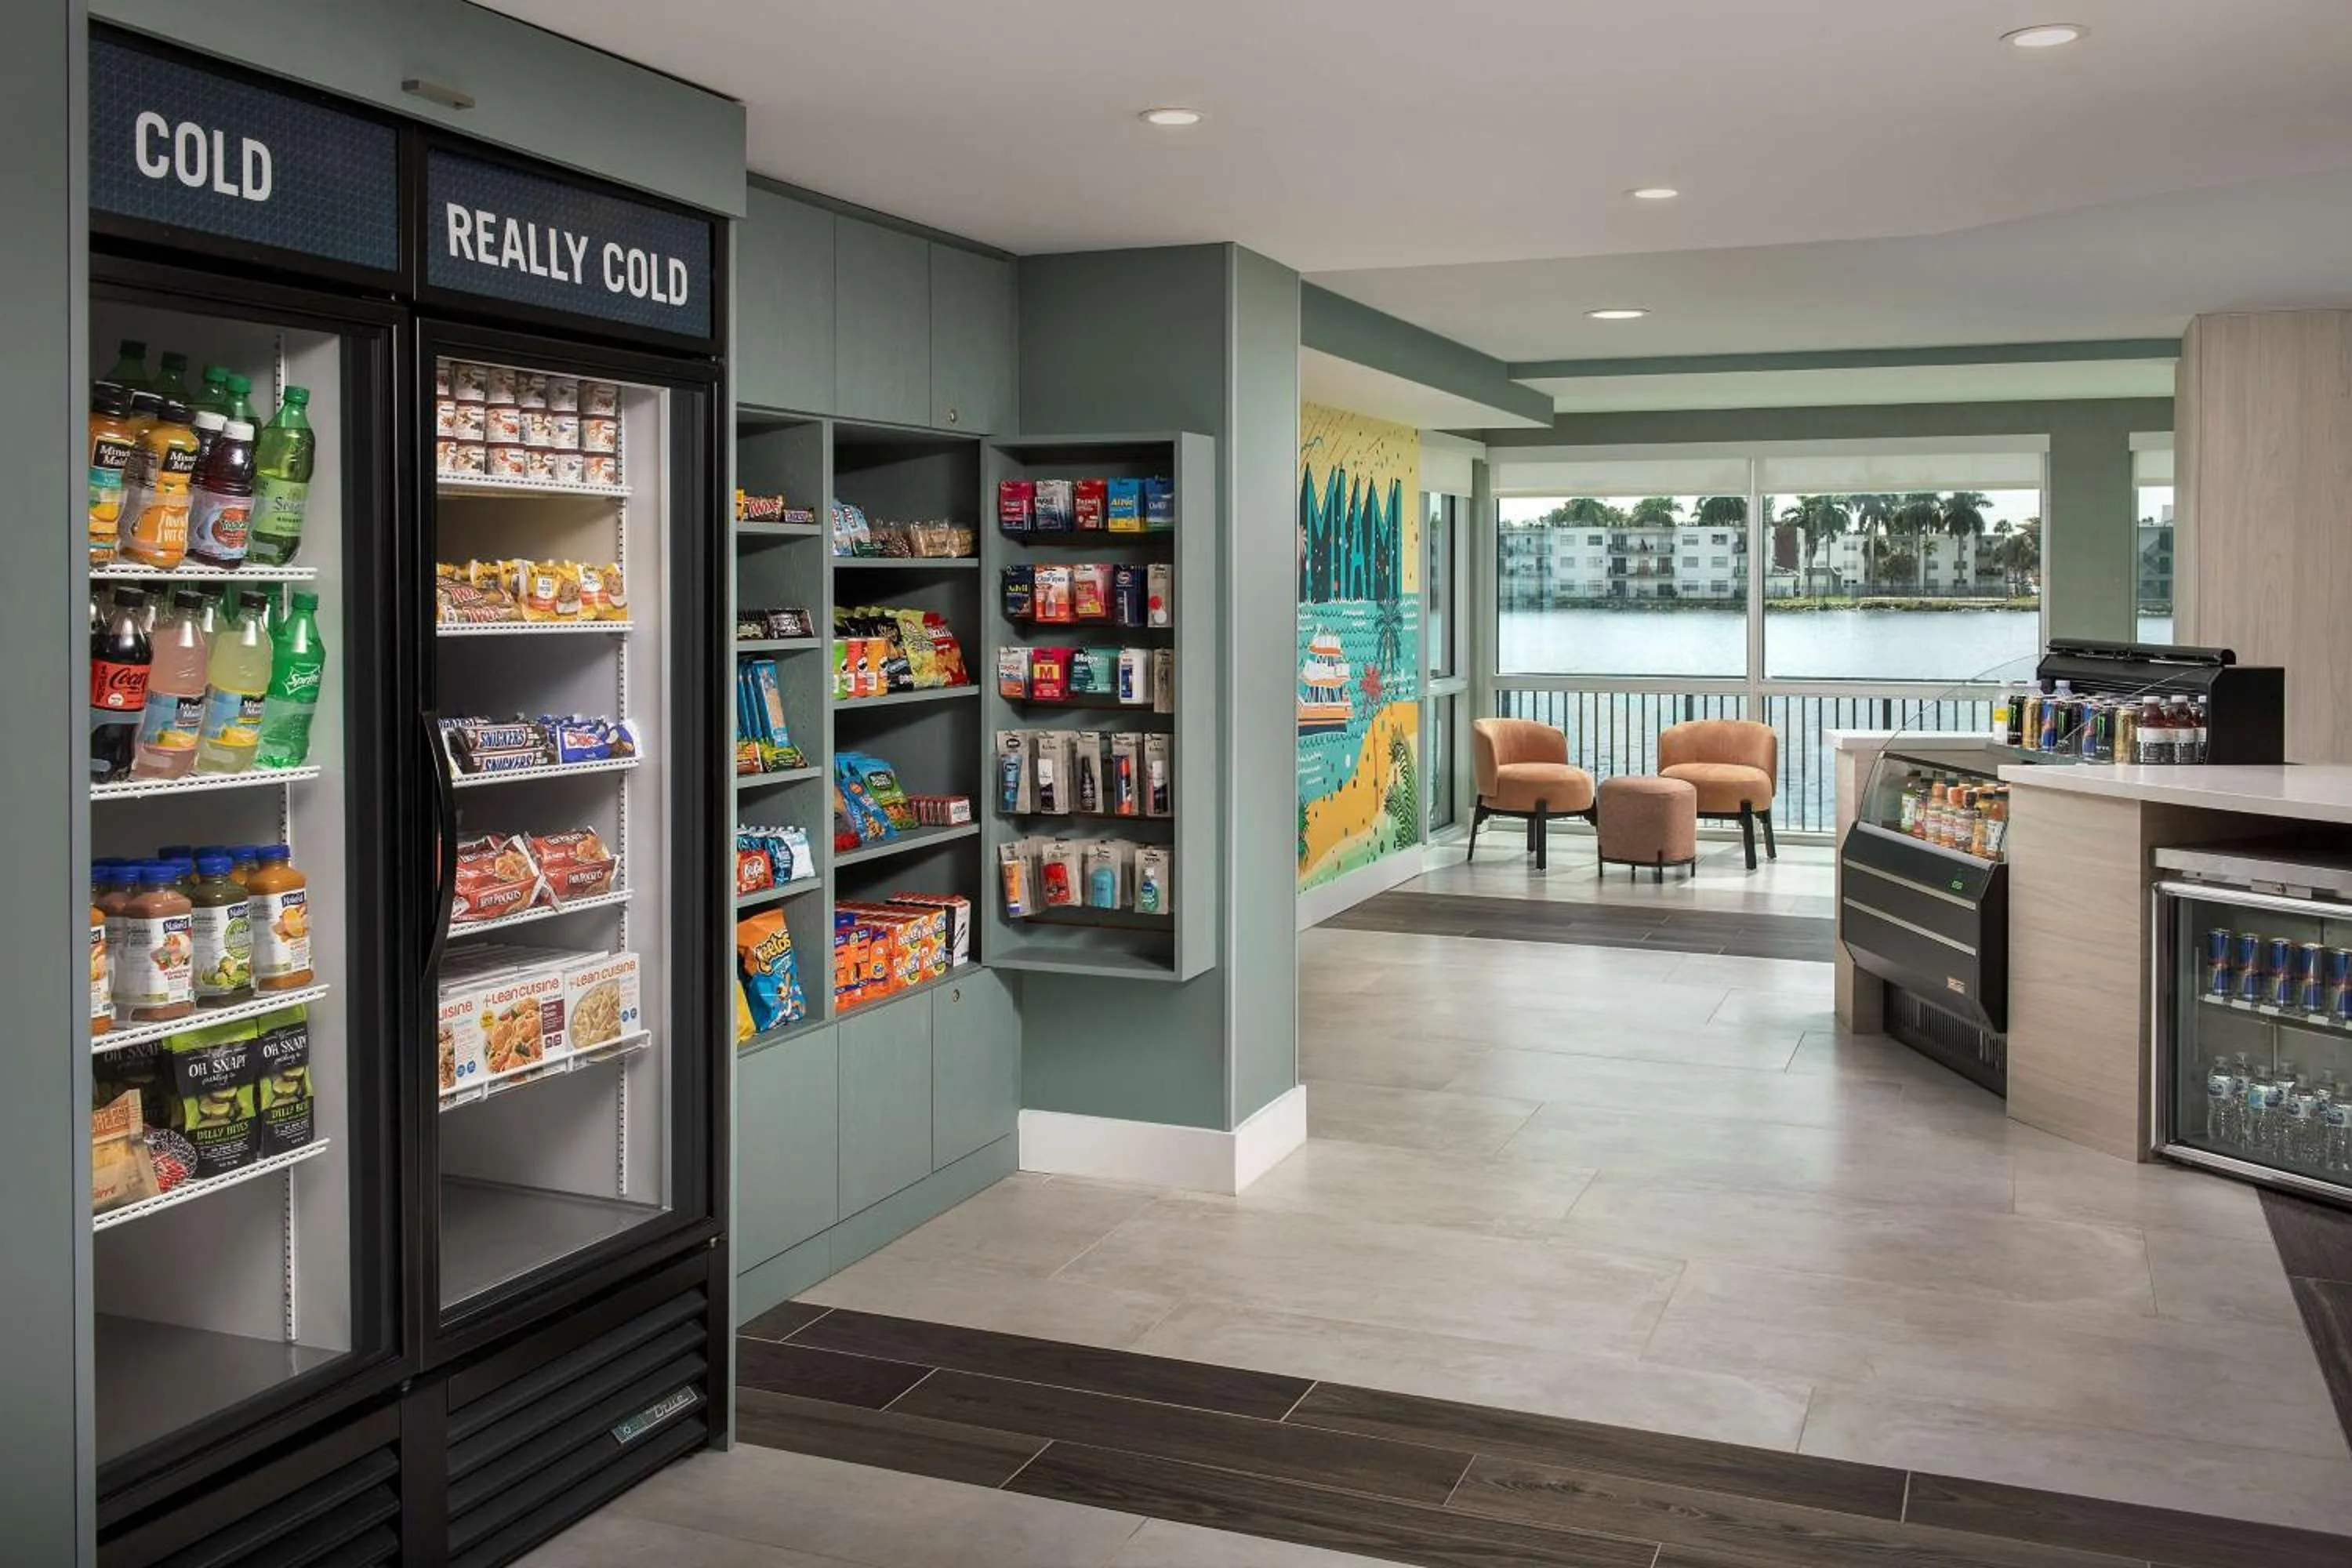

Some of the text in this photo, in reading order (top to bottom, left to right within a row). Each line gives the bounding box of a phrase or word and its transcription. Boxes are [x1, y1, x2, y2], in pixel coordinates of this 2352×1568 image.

[135, 111, 272, 201] COLD
[446, 201, 688, 307] REALLY COLD
[480, 730, 524, 747] SNICKERS
[485, 755, 532, 771] SNICKERS
[440, 1000, 473, 1021] uisine
[263, 1035, 307, 1058] OH SNAP!
[189, 1054, 246, 1078] OH SNAP!
